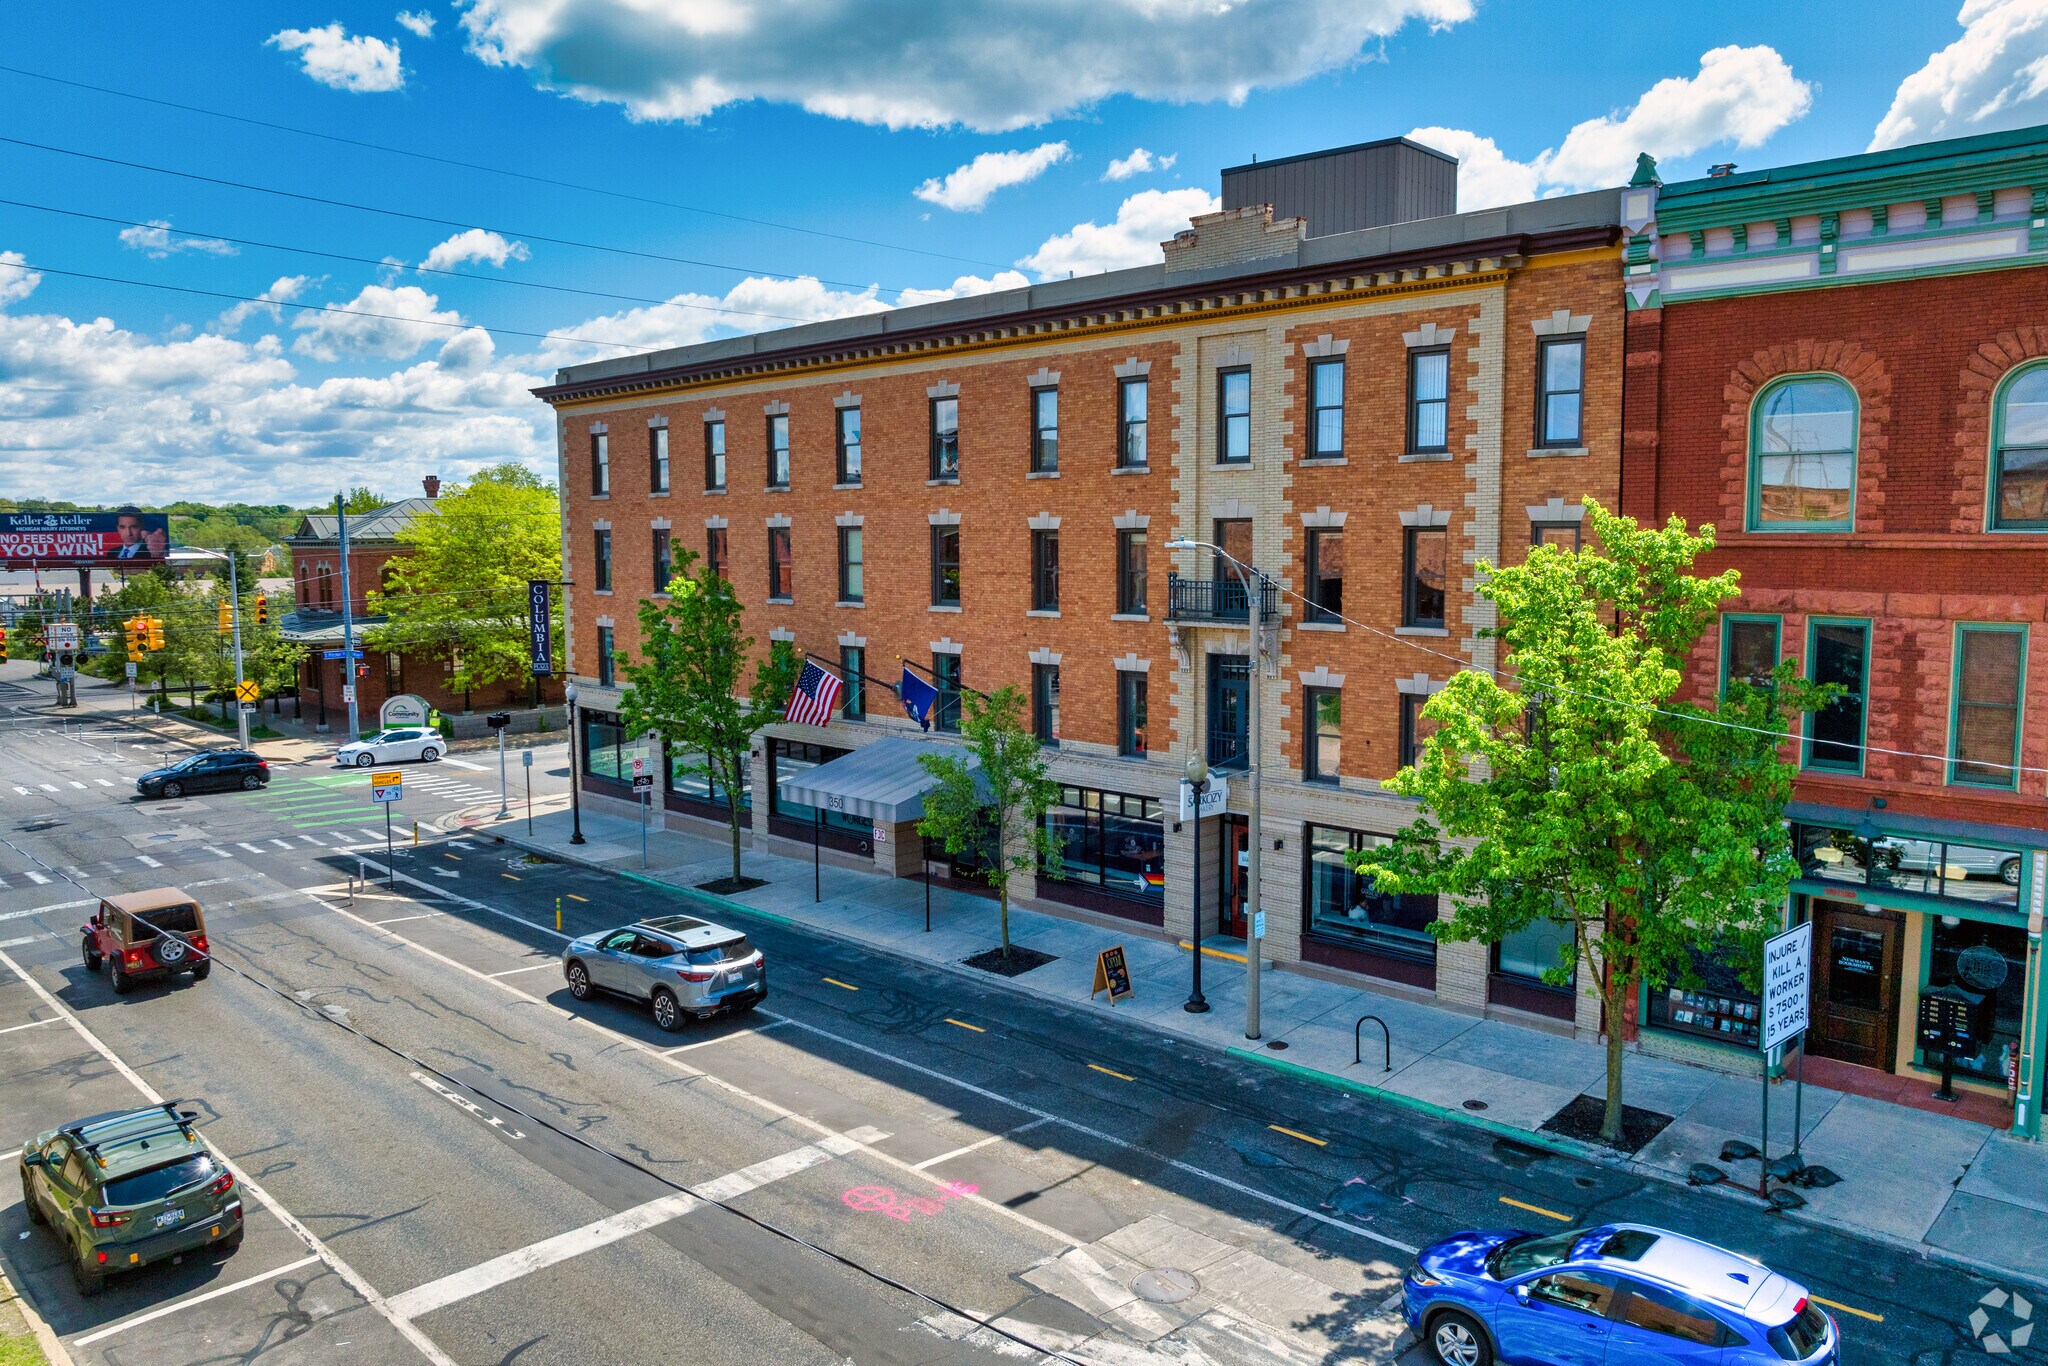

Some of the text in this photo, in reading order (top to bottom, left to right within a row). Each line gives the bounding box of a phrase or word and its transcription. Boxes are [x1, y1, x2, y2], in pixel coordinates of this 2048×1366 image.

[10, 515, 42, 525] Keller
[60, 514, 92, 525] Keller
[0, 534, 96, 544] NO FEES UNTIL
[1, 544, 48, 556] YOU
[533, 585, 546, 662] COLUMBIA
[828, 796, 844, 810] 350
[1188, 792, 1222, 808] SKOZY
[1768, 940, 1798, 964] INJURE
[1772, 956, 1802, 980] KILL A
[1769, 972, 1804, 1000] WORKER
[1767, 1024, 1776, 1038] 15
[1778, 1008, 1804, 1032] YEARS
